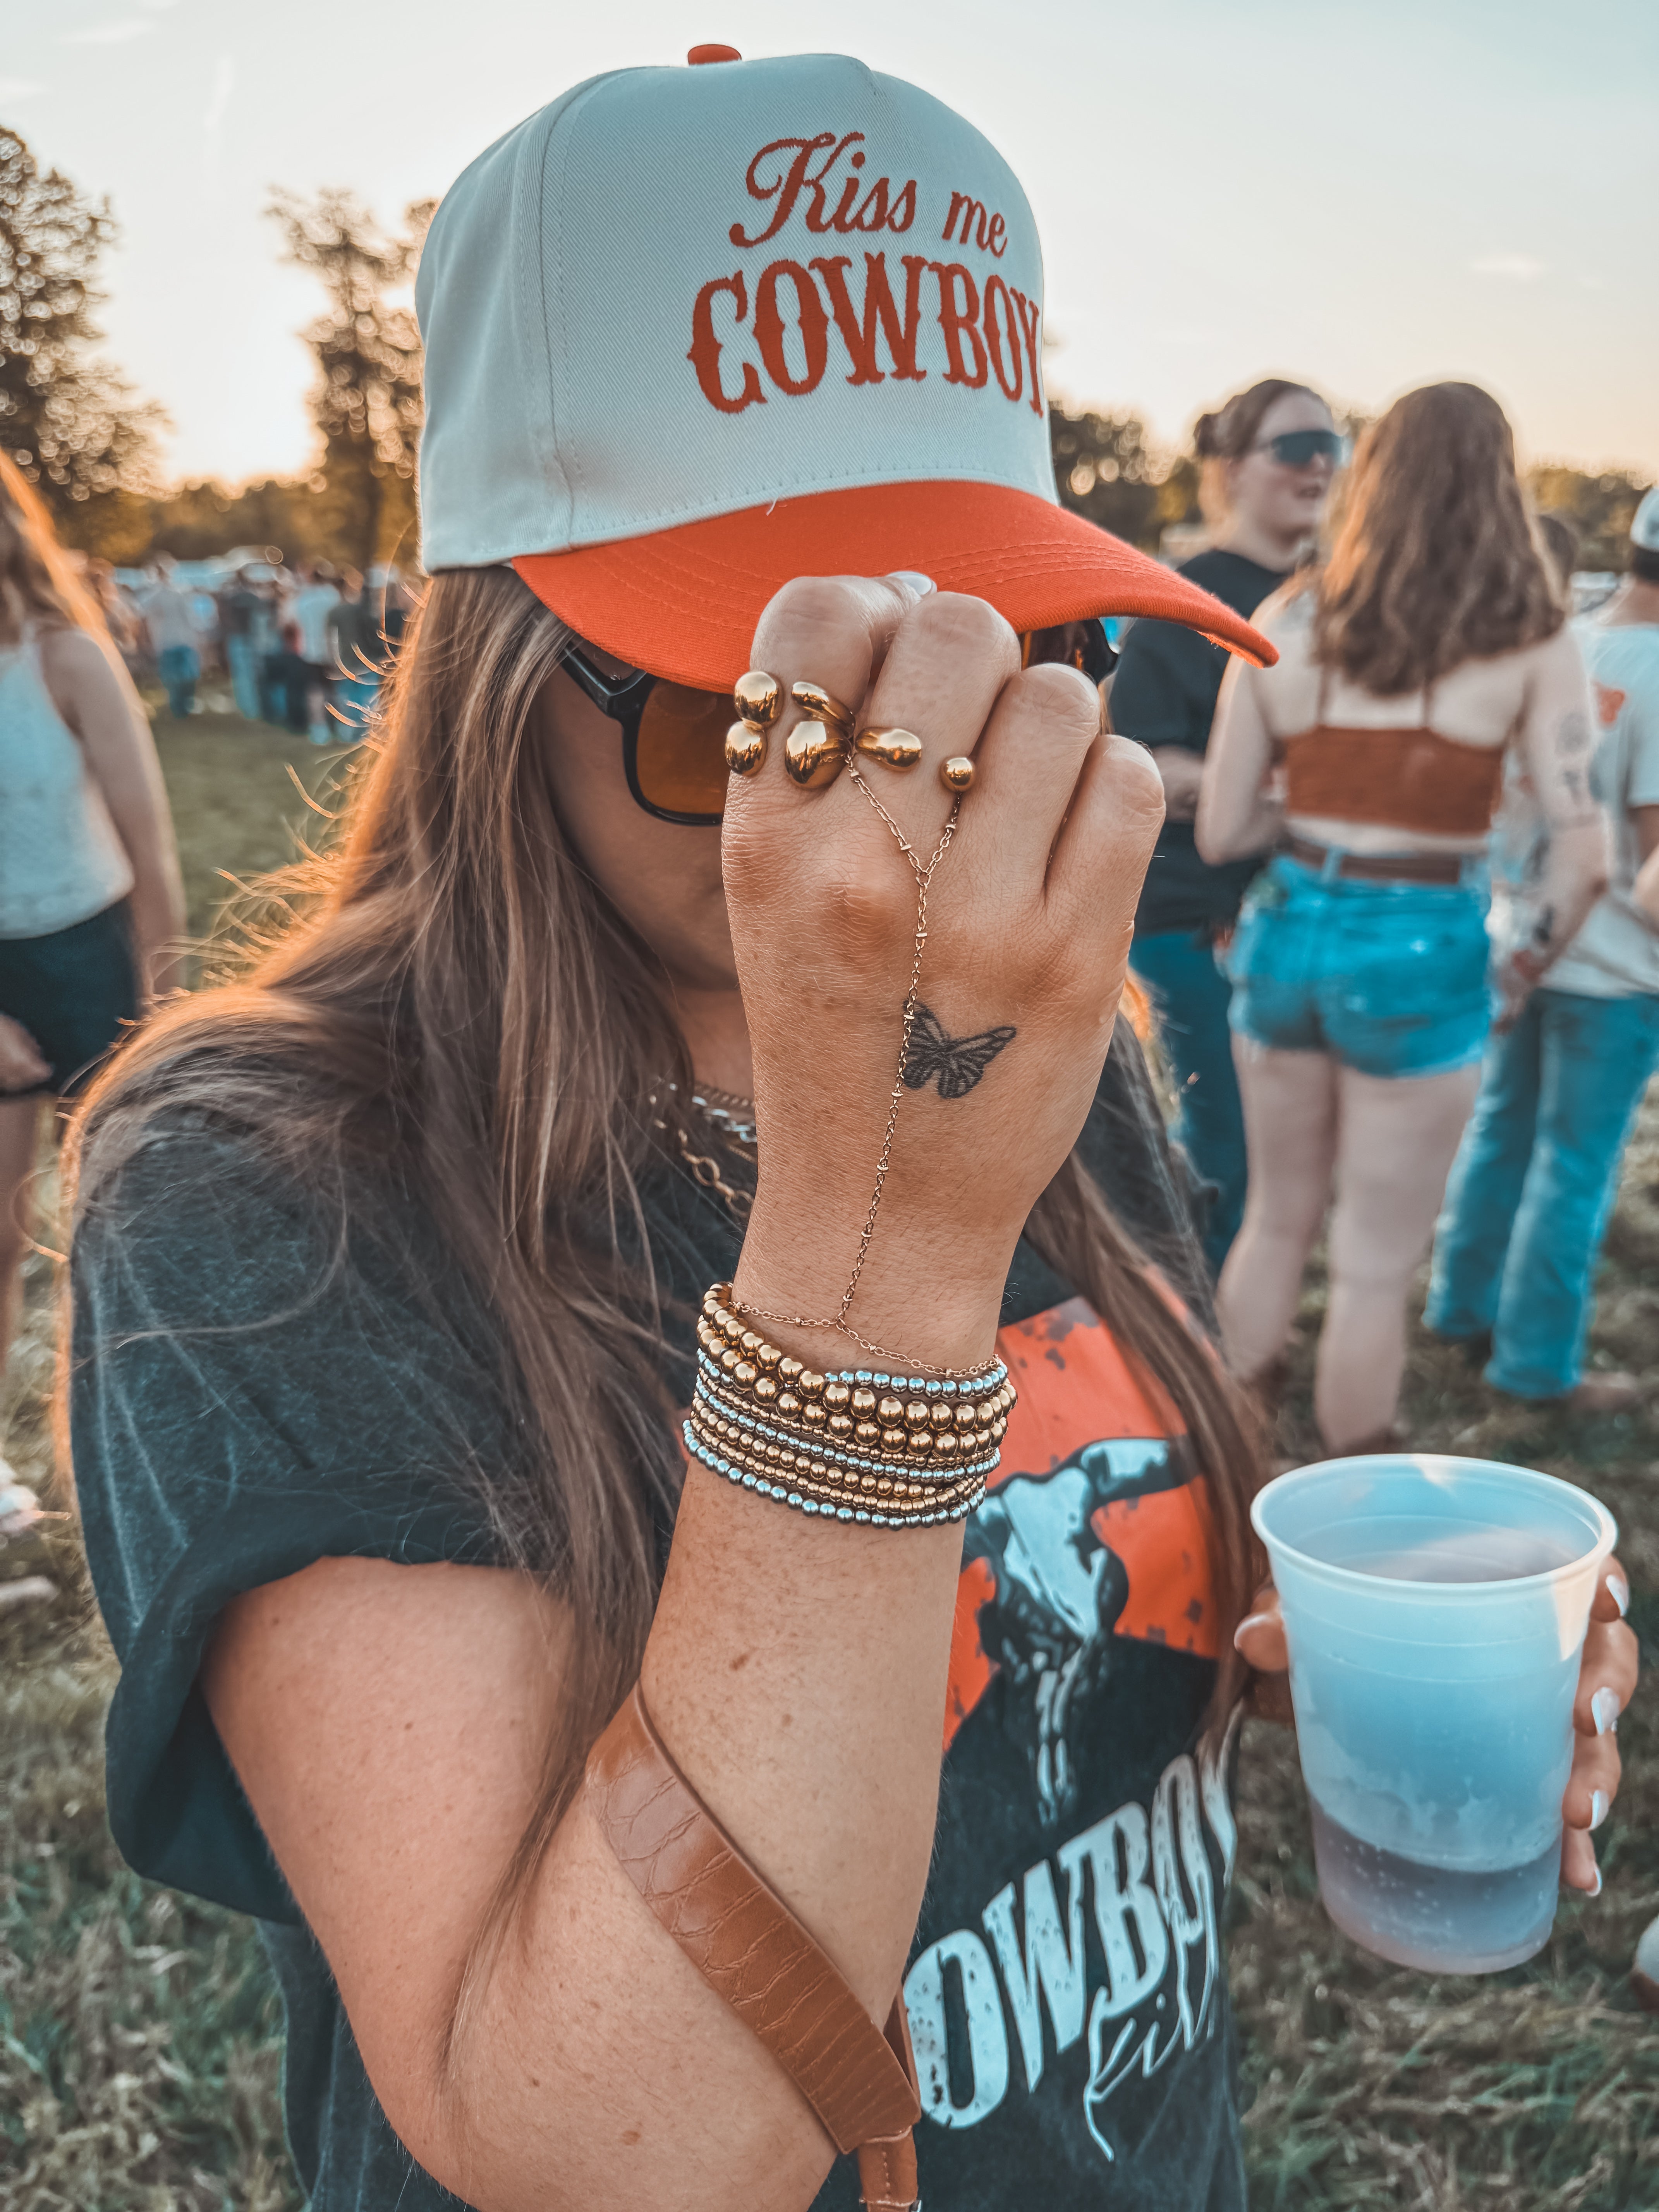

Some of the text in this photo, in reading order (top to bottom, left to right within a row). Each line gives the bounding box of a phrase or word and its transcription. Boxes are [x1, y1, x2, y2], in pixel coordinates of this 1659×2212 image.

[729, 131, 1007, 258] Kiss me
[687, 251, 1043, 419] COWBOY
[903, 1700, 1238, 2129] OWBOY
